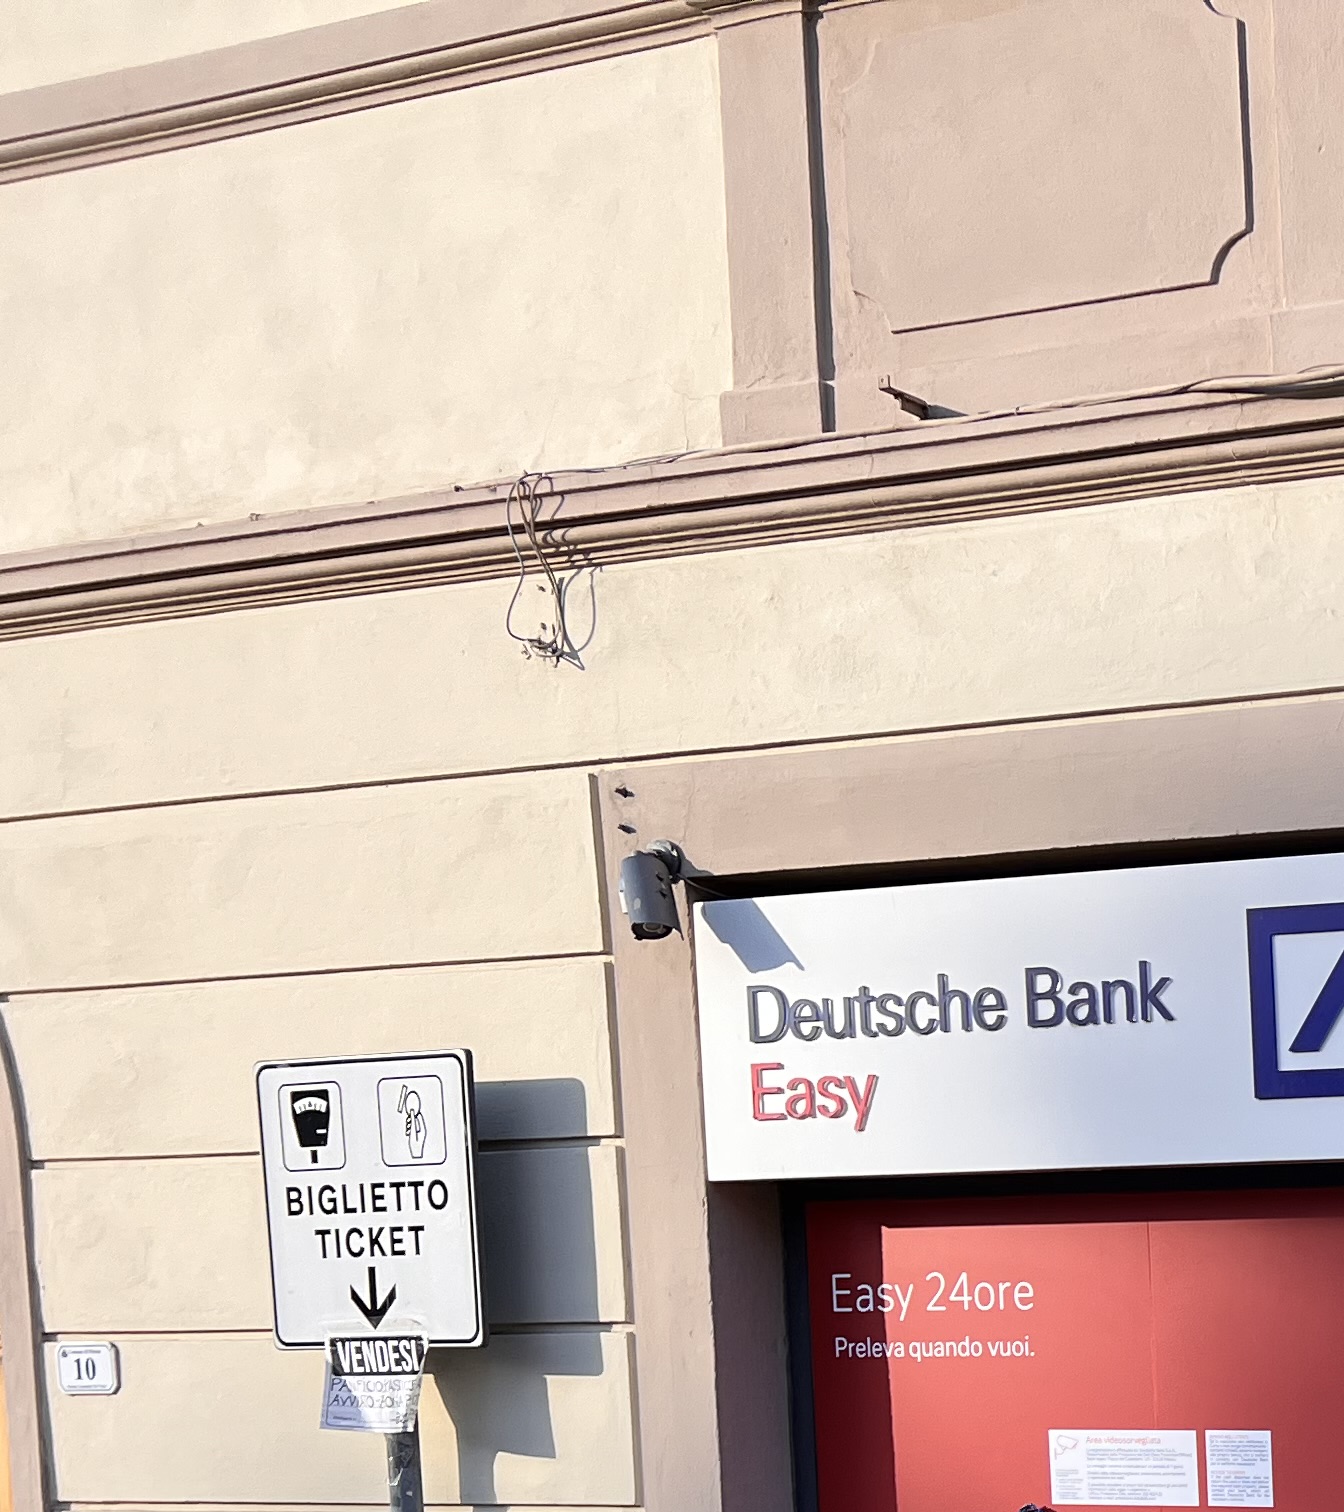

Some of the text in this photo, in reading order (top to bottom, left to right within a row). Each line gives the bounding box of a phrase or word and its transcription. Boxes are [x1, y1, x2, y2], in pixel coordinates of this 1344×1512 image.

[746, 960, 1176, 1045] Deutsche Bank
[750, 1061, 879, 1132] Easy
[286, 1179, 449, 1216] BIGLIETTO
[314, 1225, 425, 1259] TICKET
[830, 1271, 1035, 1321] Easy 24ore
[336, 1339, 420, 1373] VENDESI
[834, 1335, 1036, 1363] Preleva quando vuoi.
[74, 1357, 96, 1380] 10
